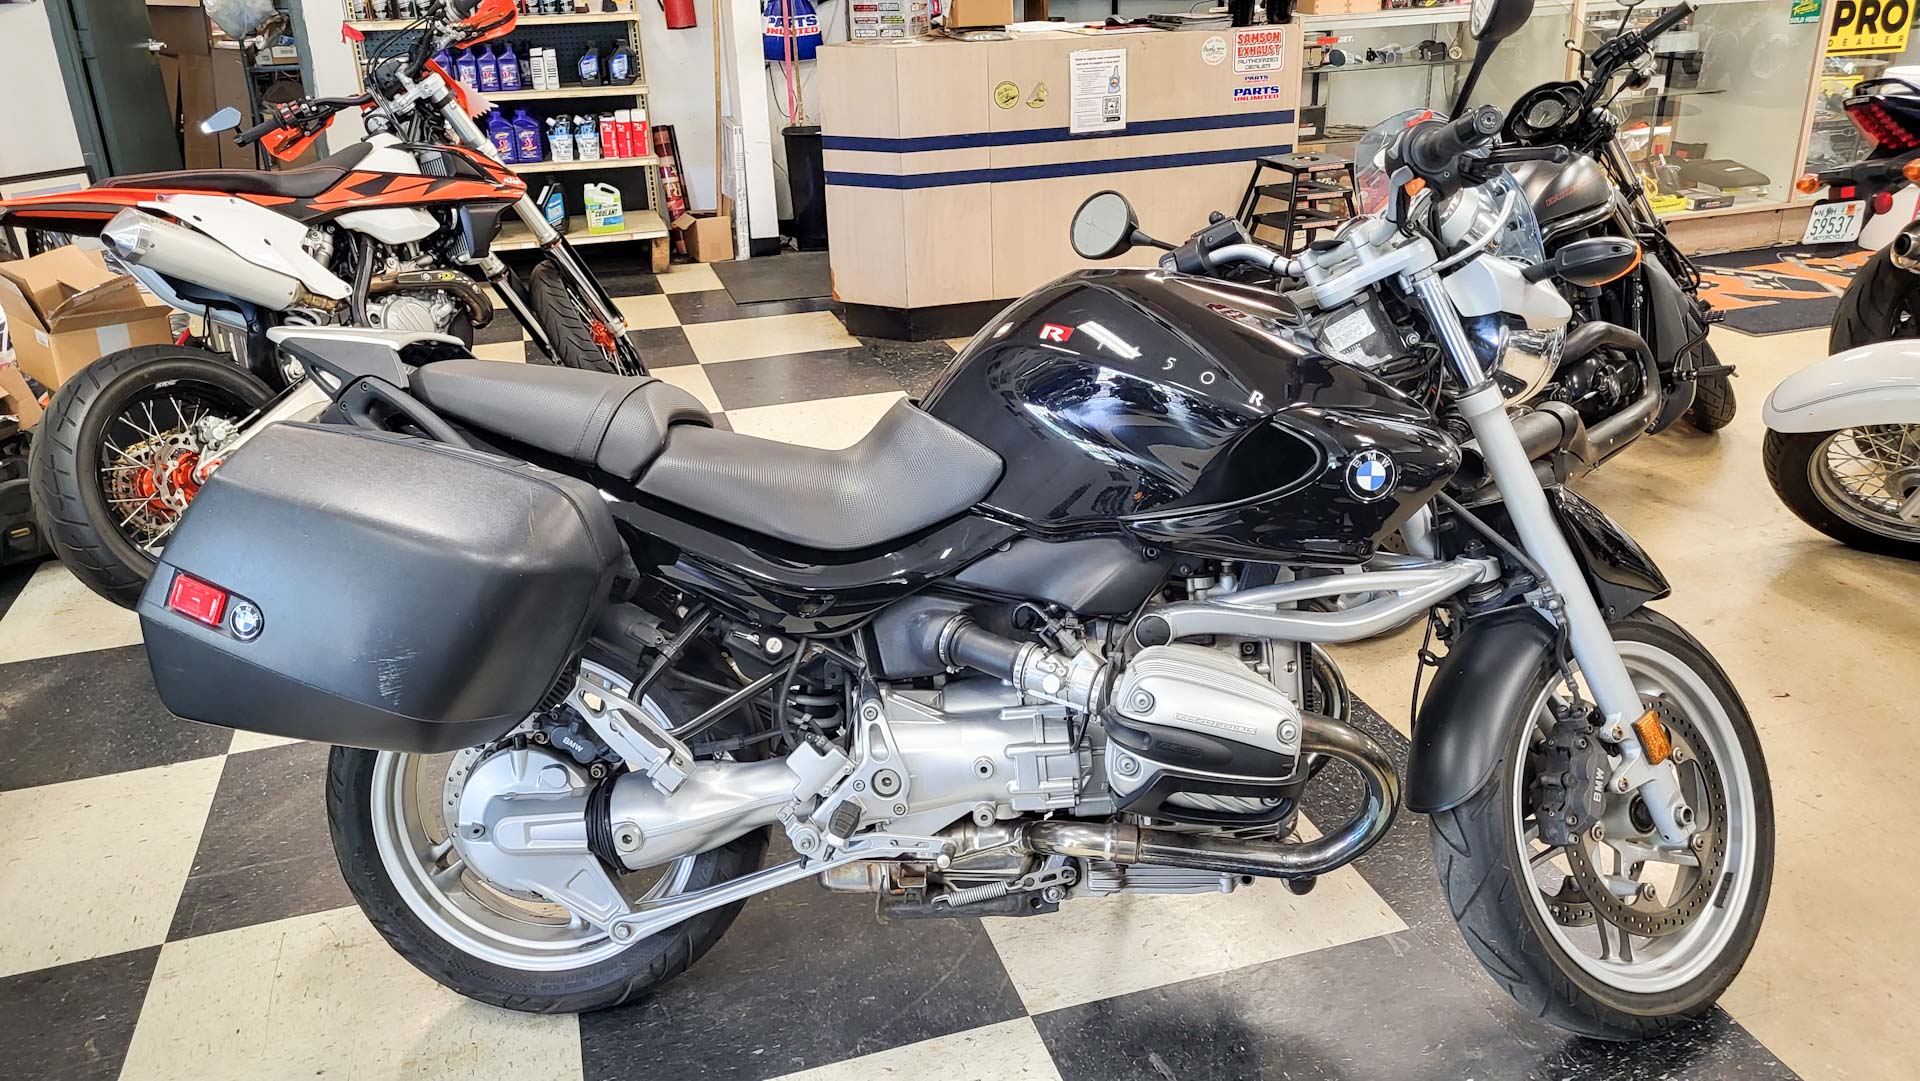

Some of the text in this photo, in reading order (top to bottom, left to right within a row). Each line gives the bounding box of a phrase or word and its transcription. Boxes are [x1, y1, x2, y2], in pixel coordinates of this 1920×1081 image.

[1830, 0, 1909, 36] PRO
[1237, 32, 1281, 45] SAMSON
[1827, 34, 1905, 48] DEALER
[1237, 44, 1281, 57] EXHAUST
[1237, 57, 1279, 65] AUTHORIZED
[1234, 86, 1280, 97] PARTS
[1234, 94, 1280, 102] UNLIMITED
[595, 209, 618, 218] COOLANT
[1810, 215, 1854, 236] S9537
[1039, 325, 1065, 342] R
[1248, 390, 1265, 407] R
[1352, 452, 1391, 469] BMW
[562, 736, 584, 753] BMW
[1592, 768, 1606, 804] BMW
